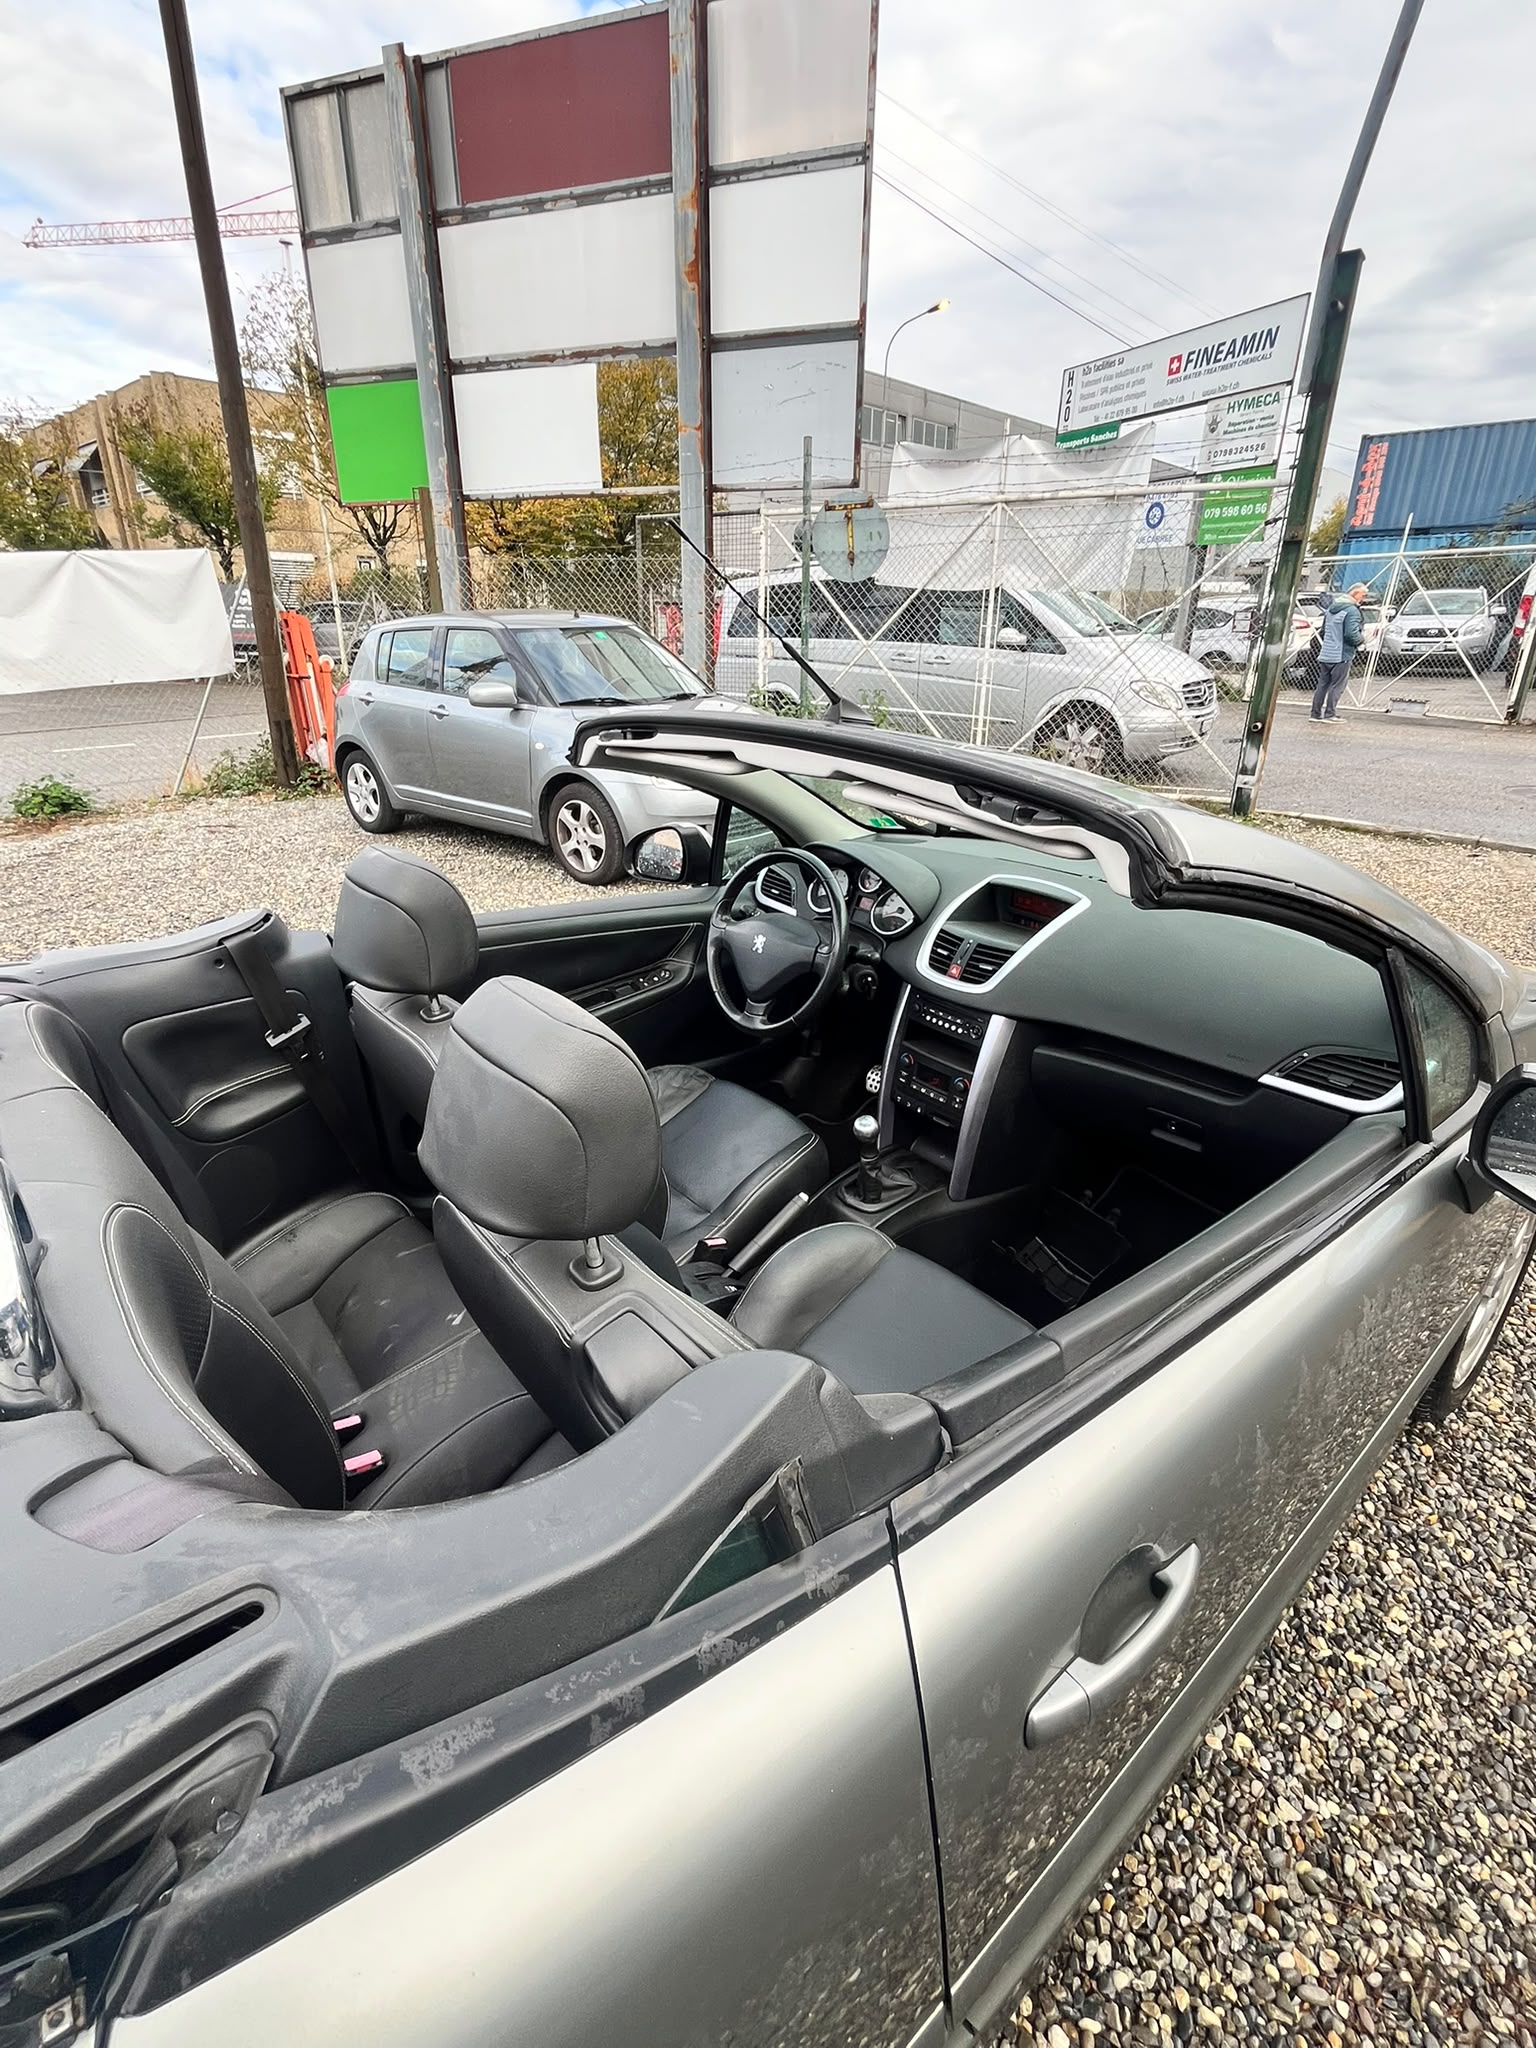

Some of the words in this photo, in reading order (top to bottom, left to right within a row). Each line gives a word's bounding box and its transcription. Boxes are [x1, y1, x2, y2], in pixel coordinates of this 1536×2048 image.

[1183, 325, 1280, 372] FINEAMIN
[1094, 360, 1116, 372] facilities
[1166, 376, 1182, 386] SWISS
[1238, 351, 1273, 367] CHEMICALS
[1227, 391, 1280, 414] HYMECA
[1223, 427, 1246, 435] Machines
[1255, 421, 1277, 430] chantier
[1056, 437, 1089, 448] Transports
[1204, 507, 1220, 519] 079
[1222, 505, 1240, 518] 598
[1241, 504, 1253, 515] 60
